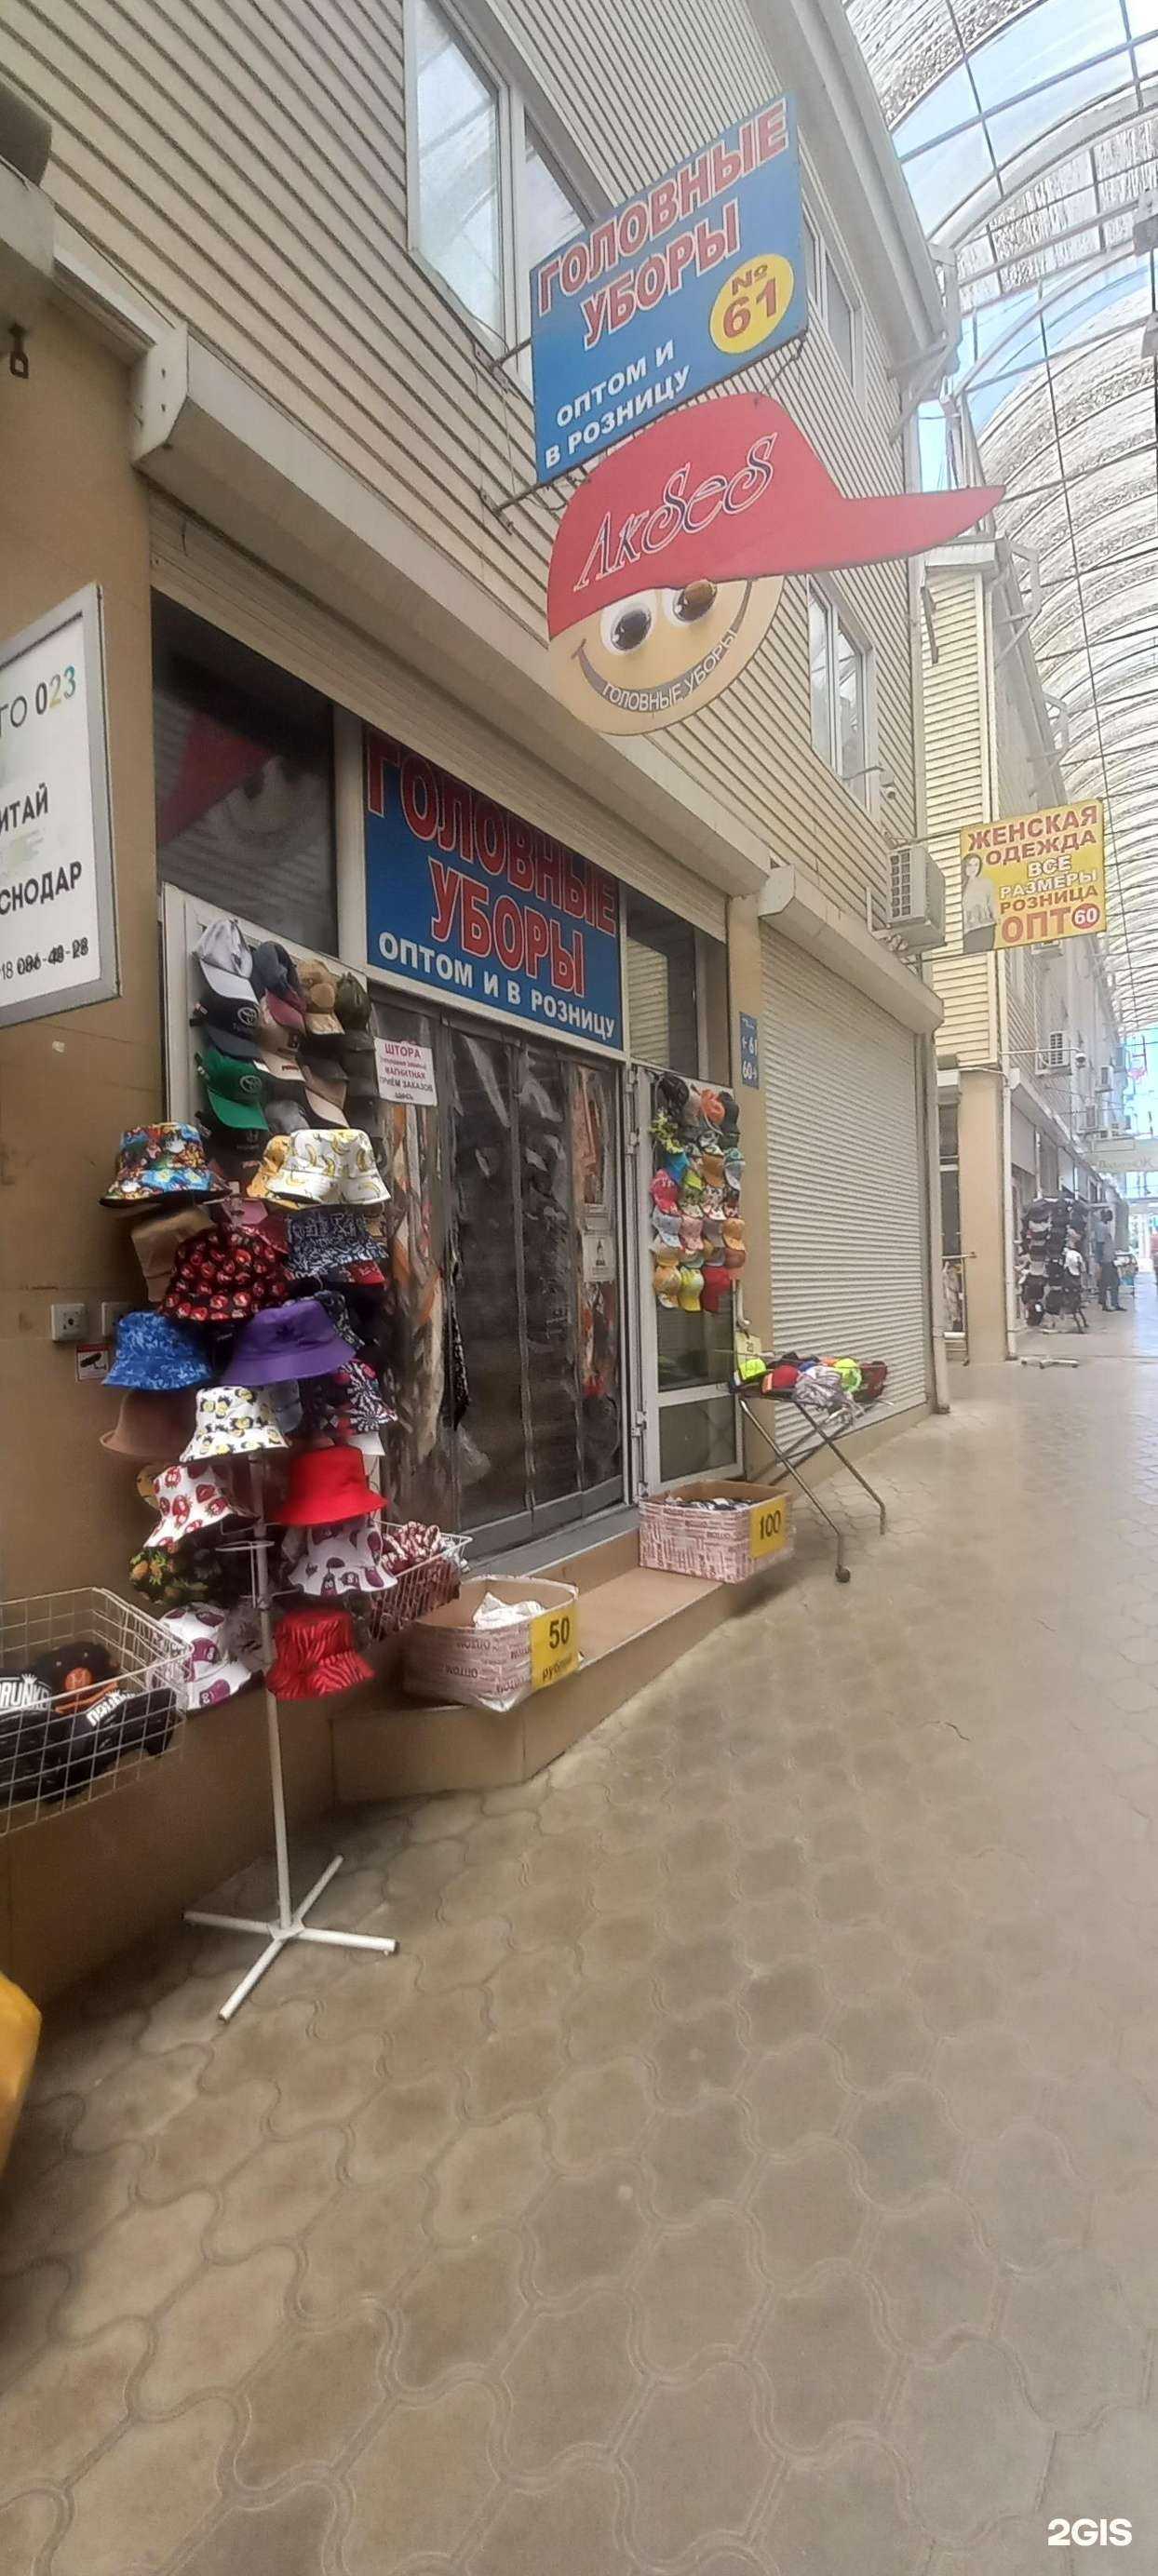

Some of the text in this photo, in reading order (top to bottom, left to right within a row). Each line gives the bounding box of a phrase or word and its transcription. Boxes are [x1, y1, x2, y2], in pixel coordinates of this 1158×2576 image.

[539, 98, 788, 317] ГОЛОВНЫЕ
[580, 197, 740, 351] УБОРЫ
[722, 278, 776, 339] 61
[557, 340, 674, 426] ОПТОМ И
[545, 365, 690, 468] В РОЗНИЦУ
[35, 666, 75, 715] 023
[602, 629, 738, 712] ГОЛОВНЫЕ УБОРЫ
[368, 738, 616, 937] ГОЛОВНЫЕ
[968, 806, 1097, 851] ЖЕНСКАЯ
[986, 830, 1097, 865] ОДЕЖДА
[1000, 869, 1097, 900] РАЗМЕРЫ
[1028, 854, 1071, 878] ВСЕ
[1001, 886, 1098, 915] РОЗНИЦА
[1002, 907, 1099, 943] ОПТ 60
[428, 856, 586, 999] УБОРЫ
[379, 932, 614, 1040] ОПТОМ И В РОЗНИЦУ
[384, 1043, 421, 1059] ШТОРА
[759, 1509, 781, 1540] 100
[549, 1617, 570, 1649] 50
